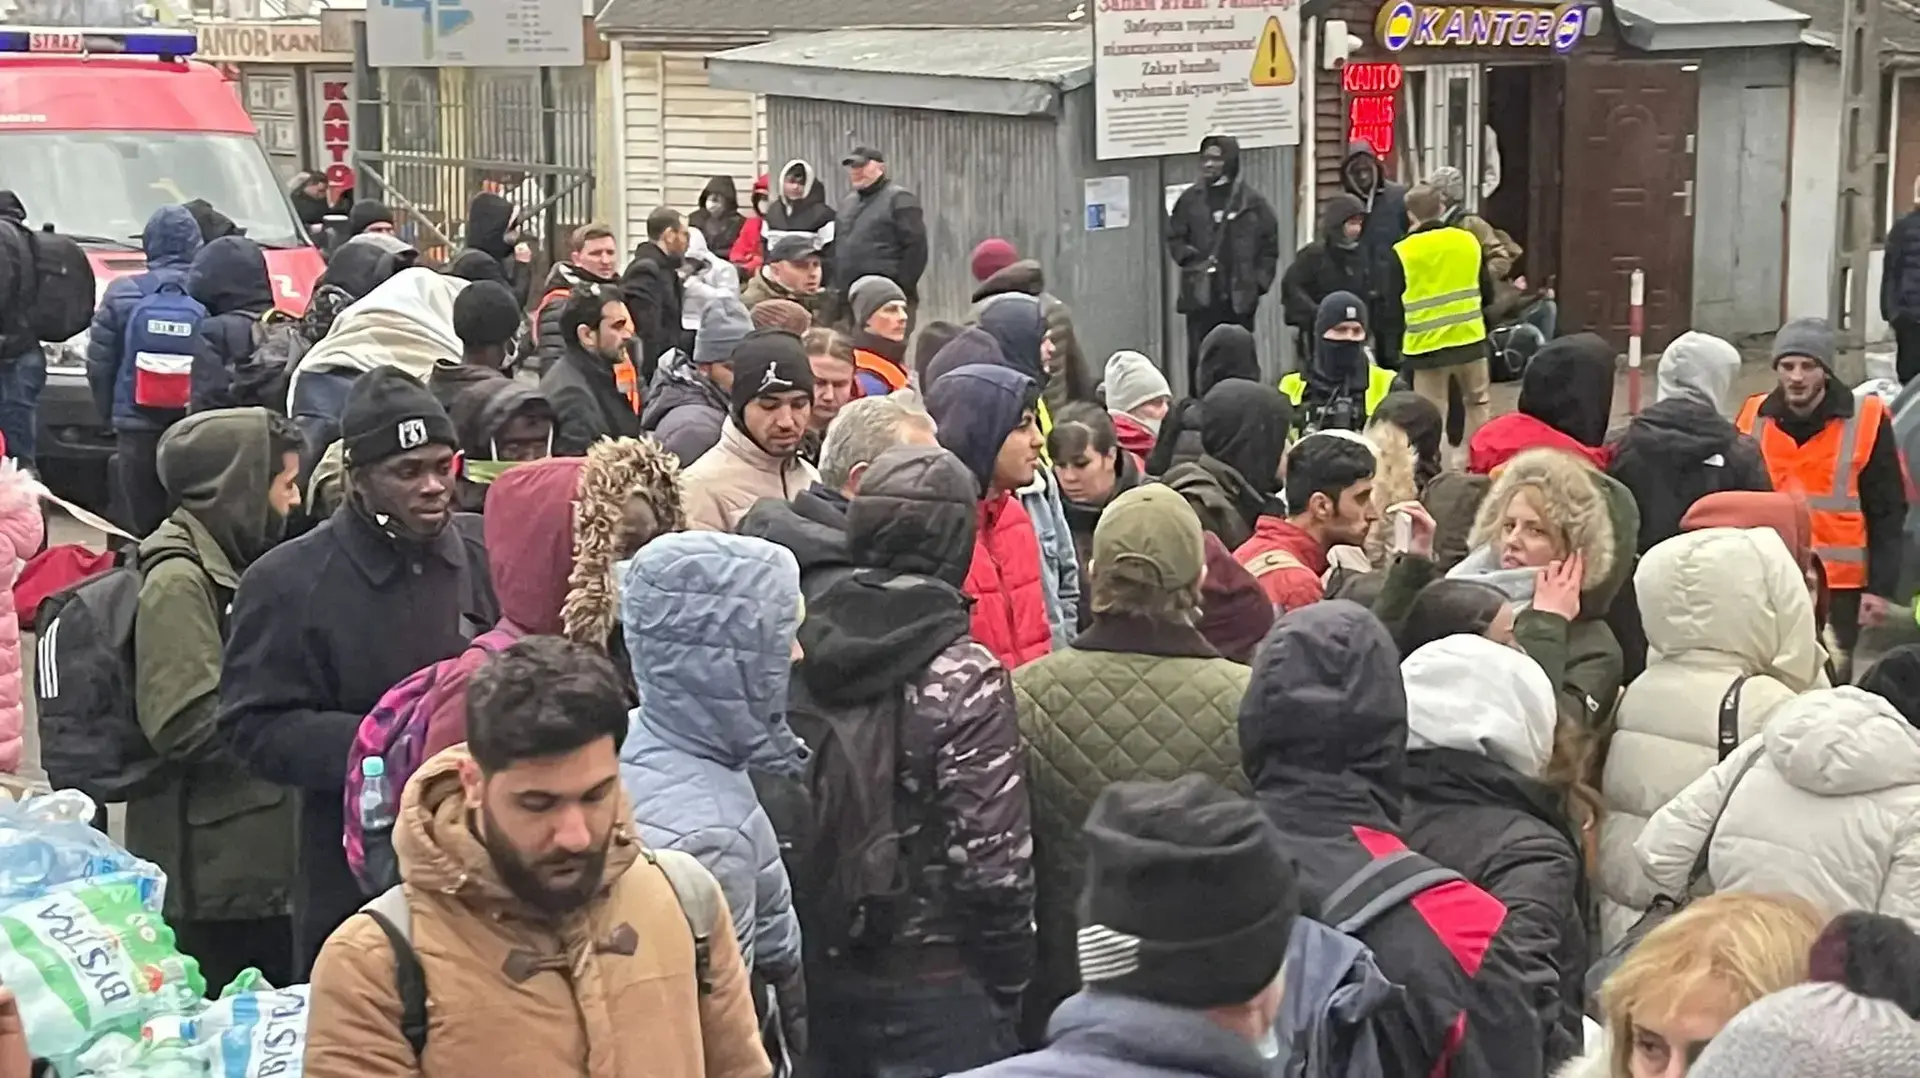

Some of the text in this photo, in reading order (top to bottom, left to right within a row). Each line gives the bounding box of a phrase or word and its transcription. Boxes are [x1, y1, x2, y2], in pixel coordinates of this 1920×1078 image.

[200, 28, 269, 57] ANTOR
[1413, 9, 1555, 46] KANTOR
[322, 82, 352, 184] KANTO
[37, 903, 131, 1007] BYSTRA
